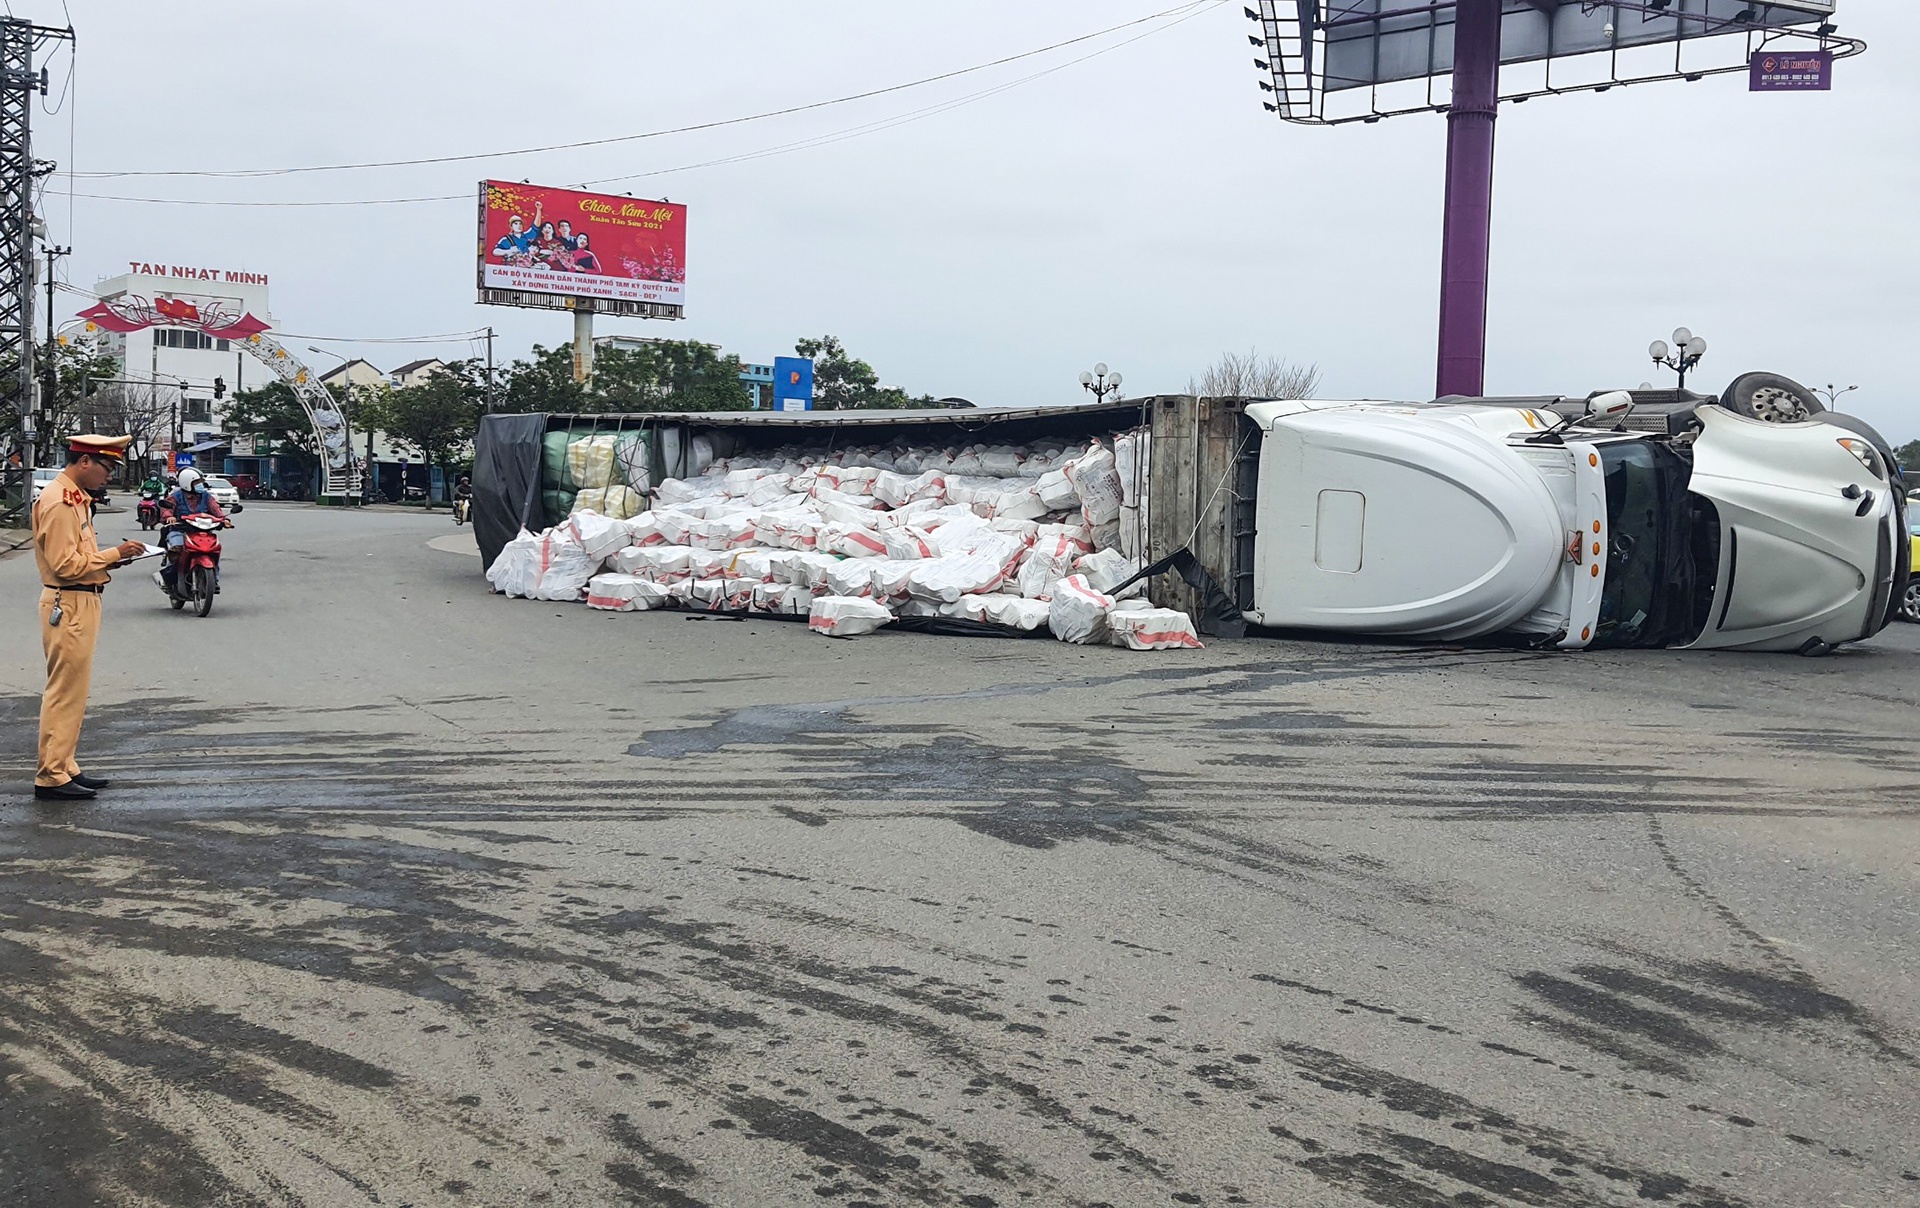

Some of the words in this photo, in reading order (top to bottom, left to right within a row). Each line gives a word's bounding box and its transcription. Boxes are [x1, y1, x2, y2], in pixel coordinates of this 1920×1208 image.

[578, 199, 612, 213] Chào
[612, 203, 646, 218] Năm
[590, 215, 610, 223] Xuân
[611, 218, 625, 226] Tân
[643, 222, 663, 230] 2021
[225, 271, 268, 286] MINH
[510, 270, 521, 278] BỘ
[534, 272, 555, 281] NHÂN
[599, 278, 614, 286] PHỐ
[615, 280, 630, 288] TAM
[512, 279, 527, 287] XÂY
[576, 285, 591, 293] PHỐ
